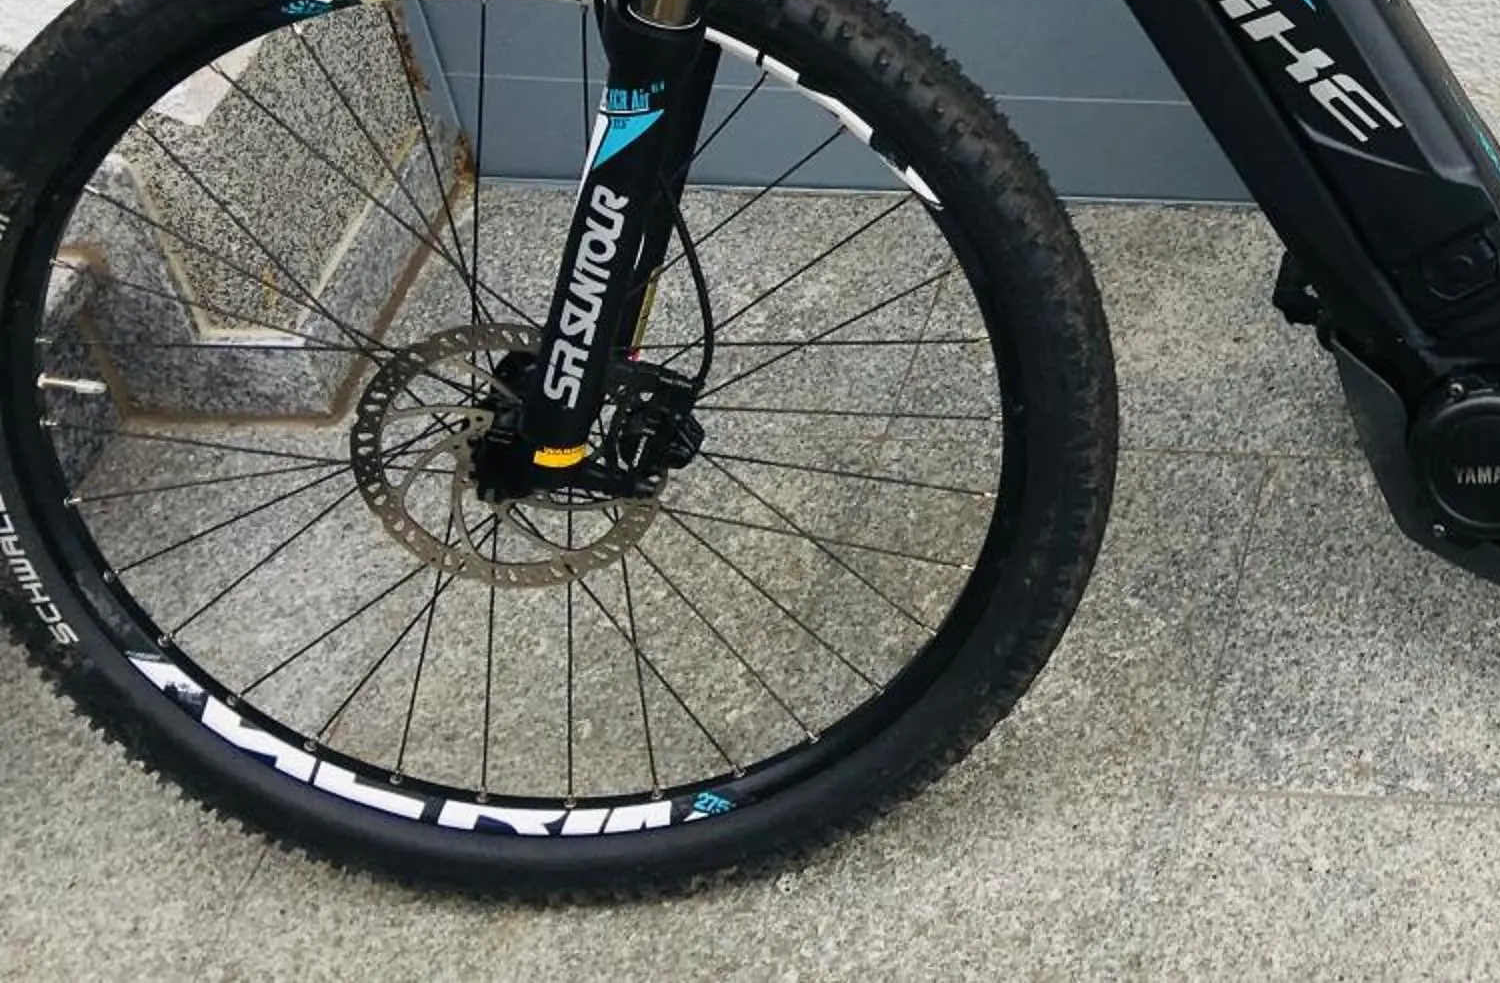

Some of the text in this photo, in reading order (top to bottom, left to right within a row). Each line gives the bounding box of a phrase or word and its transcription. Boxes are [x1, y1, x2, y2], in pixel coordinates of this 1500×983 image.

[559, 183, 630, 346] SUNTOUR
[543, 338, 590, 410] SR
[0, 494, 80, 646] SCHWAL
